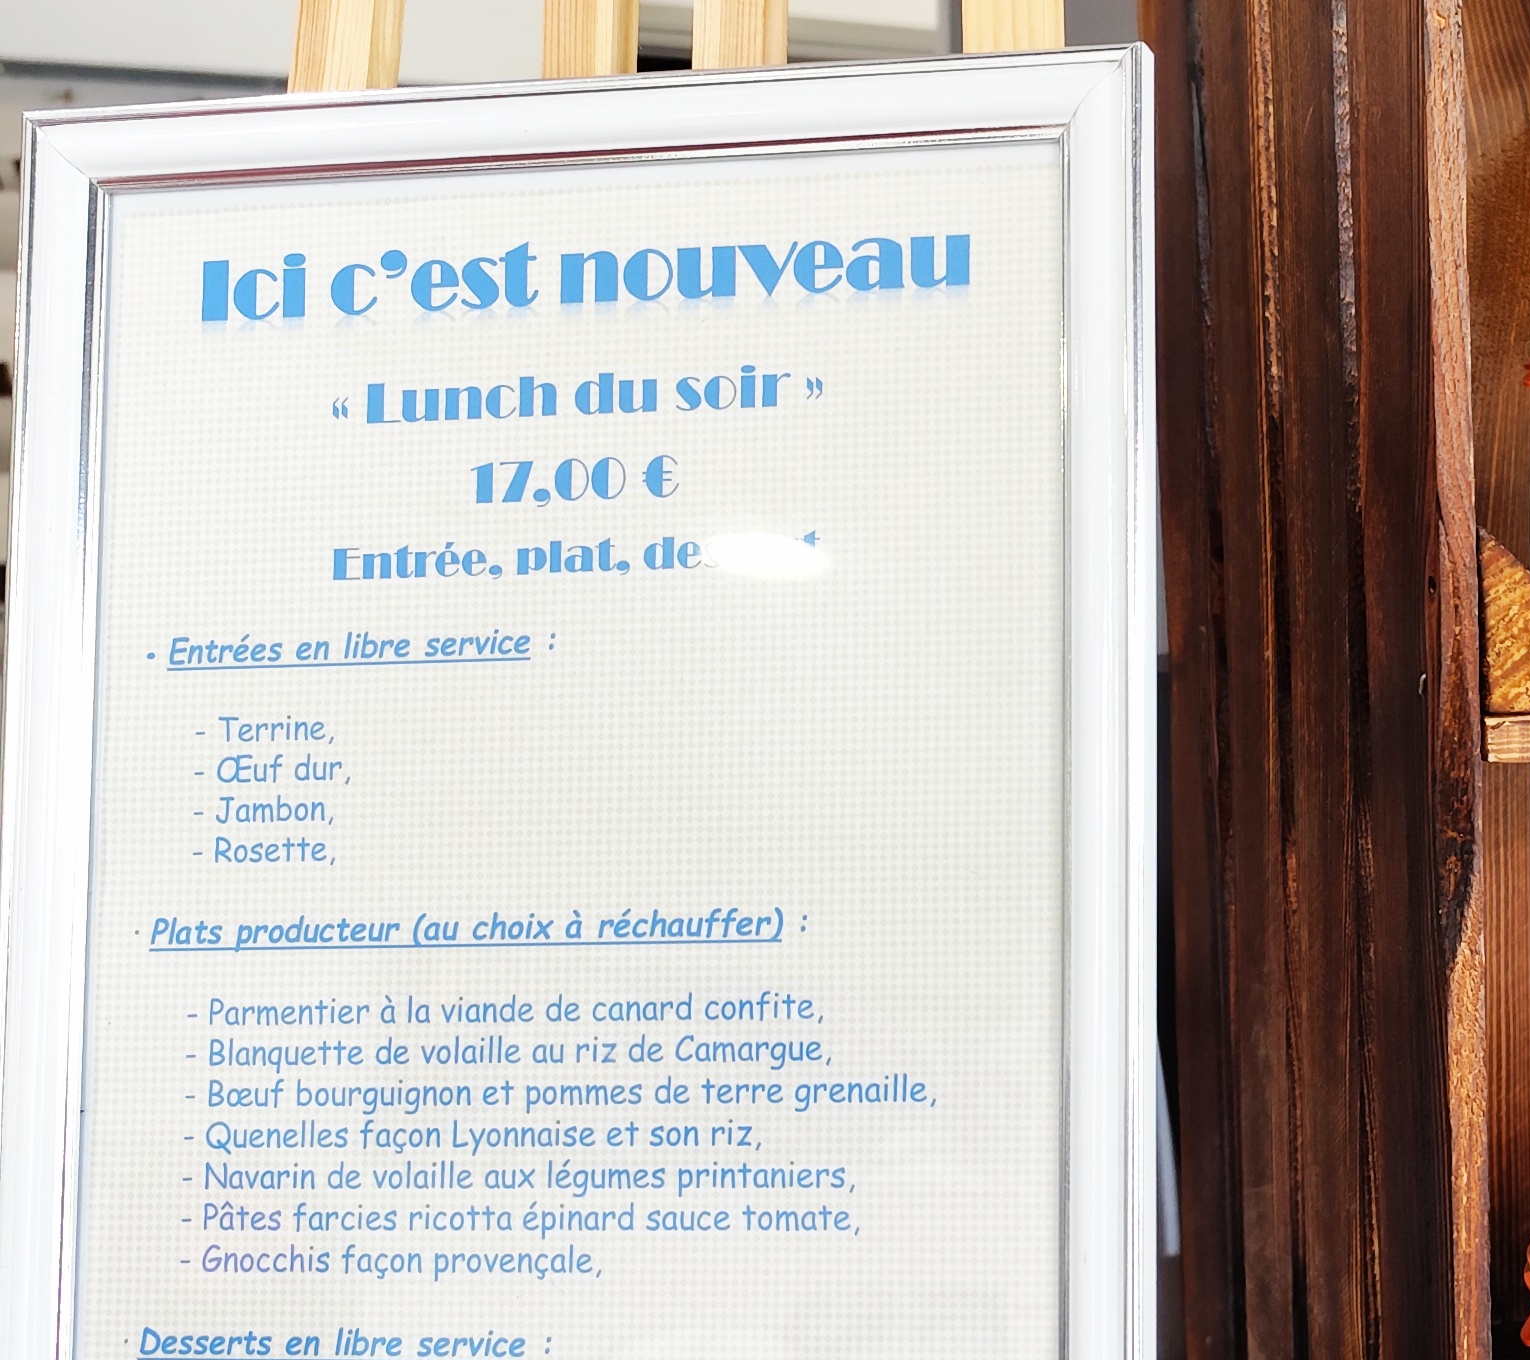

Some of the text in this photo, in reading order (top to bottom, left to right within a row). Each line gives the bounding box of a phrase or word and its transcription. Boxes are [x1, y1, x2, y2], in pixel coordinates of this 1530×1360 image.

[201, 234, 971, 322] Ici c’est nouveau
[366, 375, 558, 424] Lunch
[574, 372, 658, 416] du
[675, 364, 792, 412] soir
[470, 454, 680, 508] 17,00 €
[332, 541, 503, 581] Entrée,
[516, 537, 631, 576] plat,
[169, 633, 284, 666] Entrées
[295, 640, 330, 661] en
[343, 631, 411, 660] libre
[424, 628, 531, 658] service
[217, 714, 335, 745] Terrine,
[216, 753, 284, 784] Œuf
[294, 752, 351, 785] dur,
[215, 794, 334, 826] Jambon,
[214, 836, 336, 866] Rosette,
[150, 916, 223, 945] Plats
[234, 915, 402, 952] producteur
[410, 914, 459, 949] (au
[472, 911, 555, 941] choix
[565, 909, 583, 939] à
[595, 907, 784, 944] réchauffer)
[209, 997, 370, 1027] Parmentier
[380, 994, 396, 1024] à
[407, 995, 431, 1024] la
[440, 994, 535, 1024] viande
[545, 993, 581, 1023] de
[592, 991, 693, 1022] canard
[704, 990, 824, 1024] confite,
[208, 1037, 364, 1075] Blanquette
[375, 1036, 410, 1065] de
[420, 1034, 521, 1065] volaille
[531, 1043, 565, 1064] au
[575, 1035, 617, 1064] riz
[628, 1033, 664, 1063] de
[675, 1034, 832, 1071] Camargue,
[207, 1078, 285, 1109] Bœuf
[296, 1078, 472, 1116] bourguignon
[482, 1079, 515, 1106] et
[525, 1083, 643, 1115] pommes
[654, 1075, 690, 1105] de
[701, 1078, 784, 1105] terre
[794, 1072, 937, 1113] grenaille,
[205, 1119, 349, 1156] Quenelles
[359, 1119, 441, 1155] façon
[452, 1119, 596, 1157] Lyonnaise
[606, 1120, 640, 1147] et
[649, 1125, 699, 1147] son
[711, 1118, 762, 1151] riz,
[204, 1161, 316, 1190] Navarin
[327, 1160, 362, 1190] de
[372, 1159, 474, 1190] volaille
[484, 1168, 536, 1190] aux
[547, 1158, 666, 1198] légumes
[677, 1160, 855, 1198] printaniers,
[203, 1200, 282, 1232] Pâtes
[292, 1201, 398, 1233] farcies
[409, 1203, 513, 1232] ricotta
[522, 1200, 635, 1241] épinard
[645, 1209, 731, 1232] sauce
[741, 1204, 860, 1236] tomate,
[201, 1243, 331, 1274] Gnocchis
[341, 1243, 423, 1280] façon
[434, 1243, 602, 1282] provençale,
[139, 1326, 273, 1356] Desserts
[285, 1335, 320, 1357] en
[334, 1327, 403, 1357] libre
[416, 1329, 526, 1358] service
